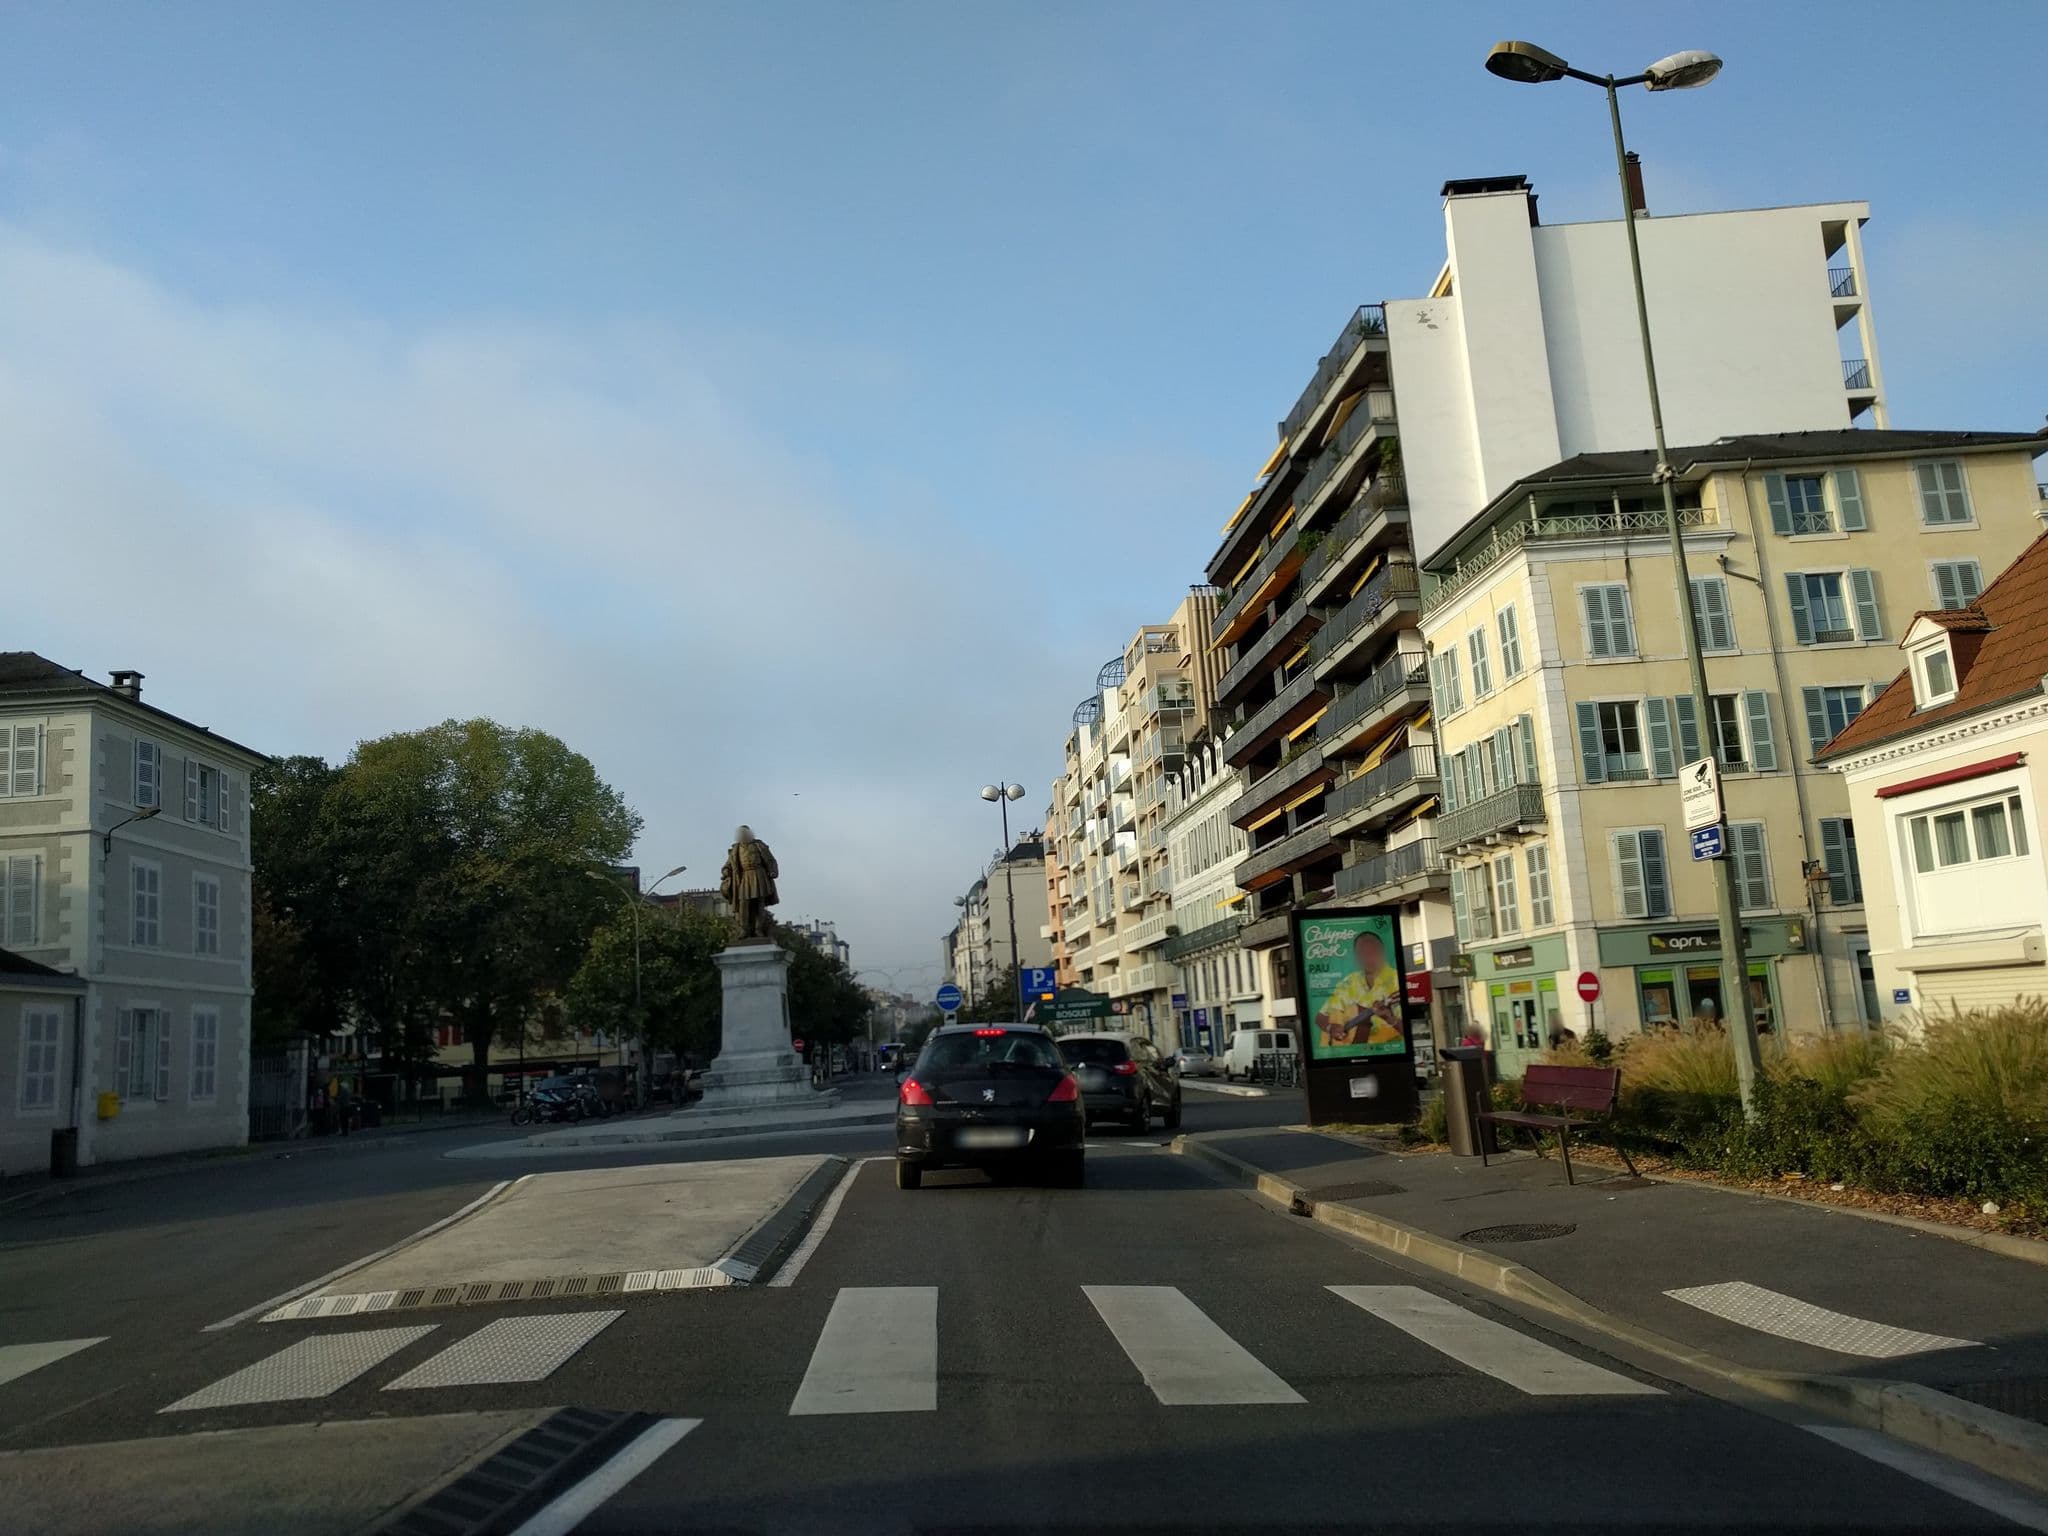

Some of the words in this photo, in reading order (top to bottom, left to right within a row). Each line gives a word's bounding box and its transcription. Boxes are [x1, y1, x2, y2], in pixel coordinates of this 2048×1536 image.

[1305, 925, 1358, 945] Calypso
[1306, 942, 1347, 959] Rose
[1308, 964, 1330, 973] PAU
[1032, 969, 1045, 987] P
[1056, 1009, 1091, 1019] BOSQUET
